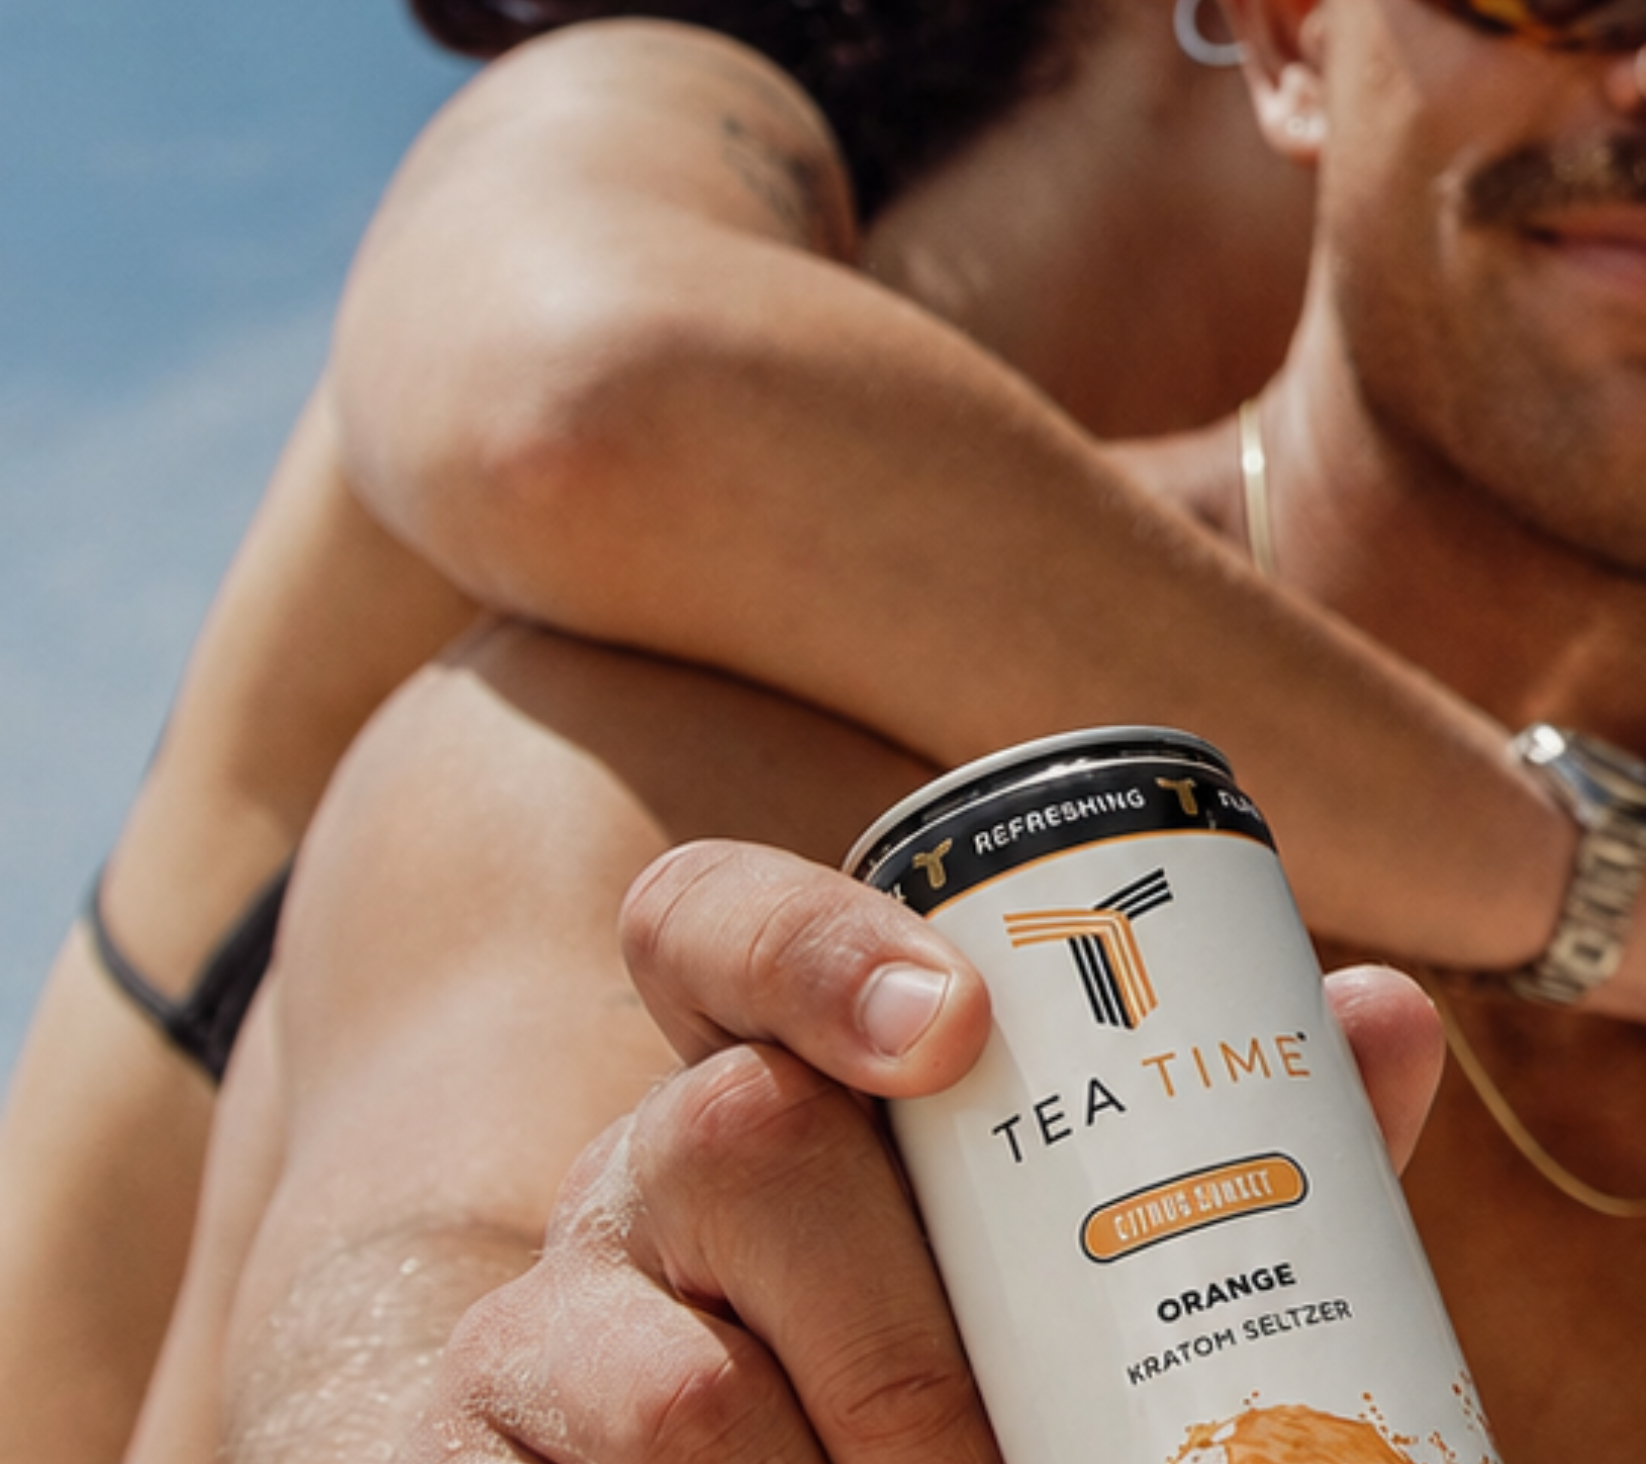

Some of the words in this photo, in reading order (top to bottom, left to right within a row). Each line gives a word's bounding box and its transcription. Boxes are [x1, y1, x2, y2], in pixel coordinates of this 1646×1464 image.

[973, 787, 1147, 856] REFRESHING
[992, 1078, 1126, 1163] TEA
[1142, 1035, 1310, 1097] TIME
[1113, 1189, 1192, 1241] CITRUS
[1157, 1263, 1297, 1323] ORANGE
[1127, 1328, 1237, 1385] KRATOM
[1242, 1299, 1352, 1340] SELTZER
